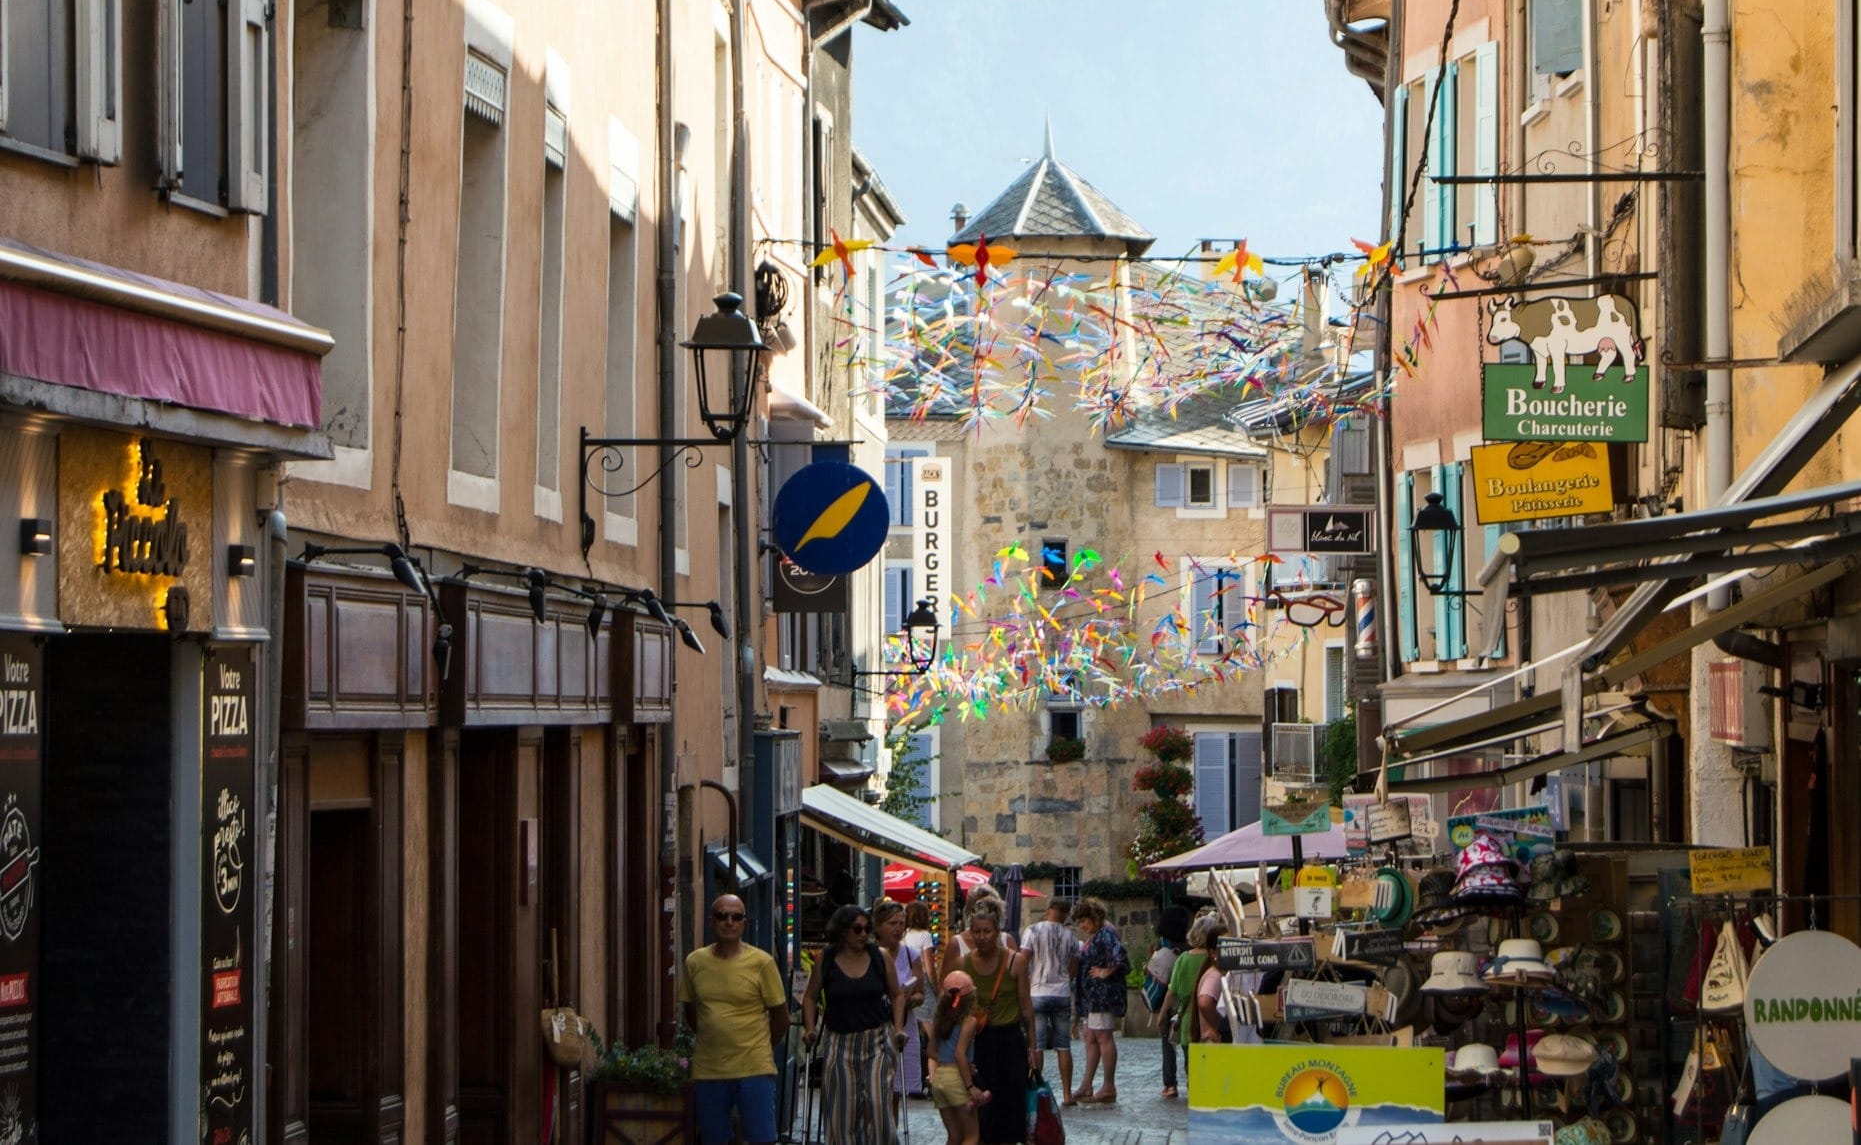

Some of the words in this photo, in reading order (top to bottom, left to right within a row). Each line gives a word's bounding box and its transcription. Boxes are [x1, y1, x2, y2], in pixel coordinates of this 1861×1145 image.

[1505, 388, 1628, 417] Boucherie
[1517, 419, 1614, 437] Charcuterie
[1486, 473, 1601, 498] Boulangerie
[1512, 494, 1584, 513] Pâtisserie
[4, 653, 30, 683] Votre
[219, 663, 241, 690] Votre
[211, 695, 248, 736] PIZZA
[1220, 946, 1253, 958] INTERDIT
[1240, 956, 1256, 966] AUX
[1276, 1061, 1306, 1098] BUREAU
[1308, 1059, 1357, 1098] MONTAGNE
